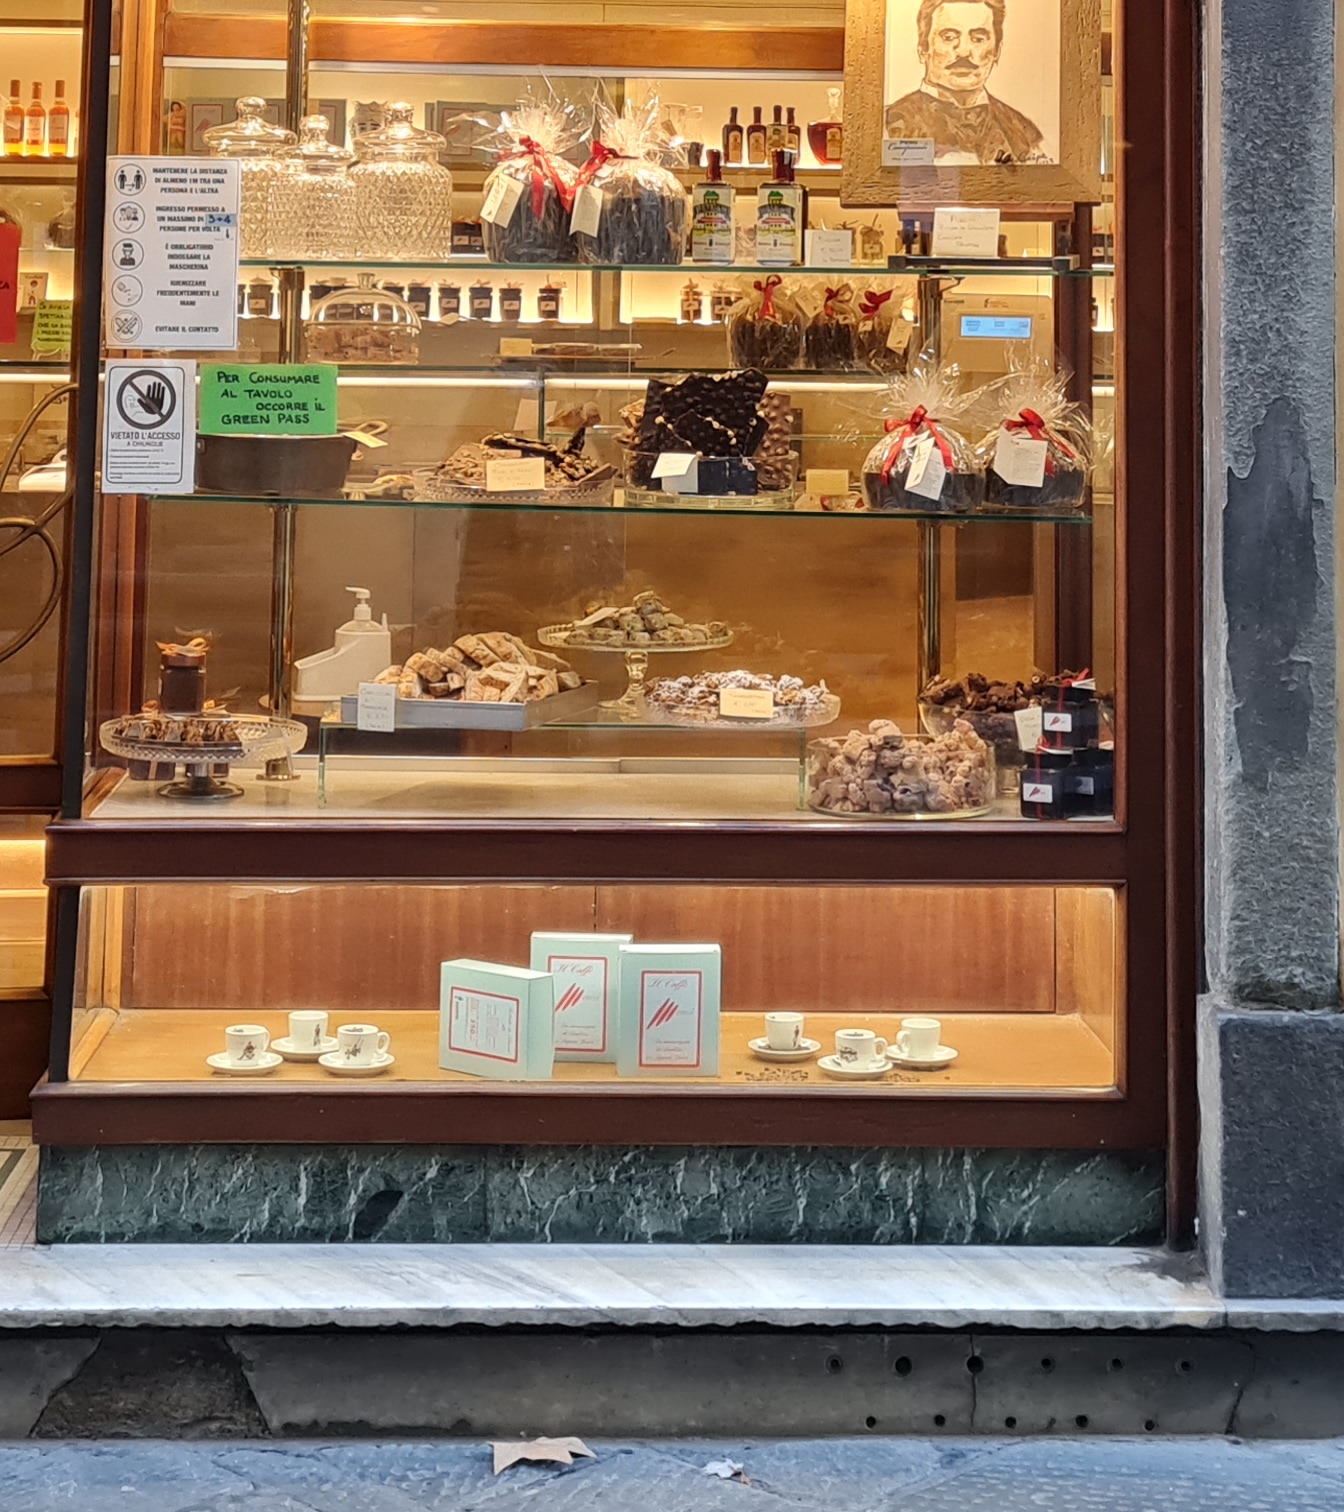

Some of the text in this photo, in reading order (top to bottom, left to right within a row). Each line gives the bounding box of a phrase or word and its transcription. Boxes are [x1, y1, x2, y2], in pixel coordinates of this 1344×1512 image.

[217, 371, 321, 384] PER CONSUMARE
[221, 388, 293, 399] AL TAVOLO
[255, 402, 309, 411] OCCORRE
[221, 413, 310, 425] GREEN PASS
[110, 432, 181, 440] VIETATO L'ACCESSO
